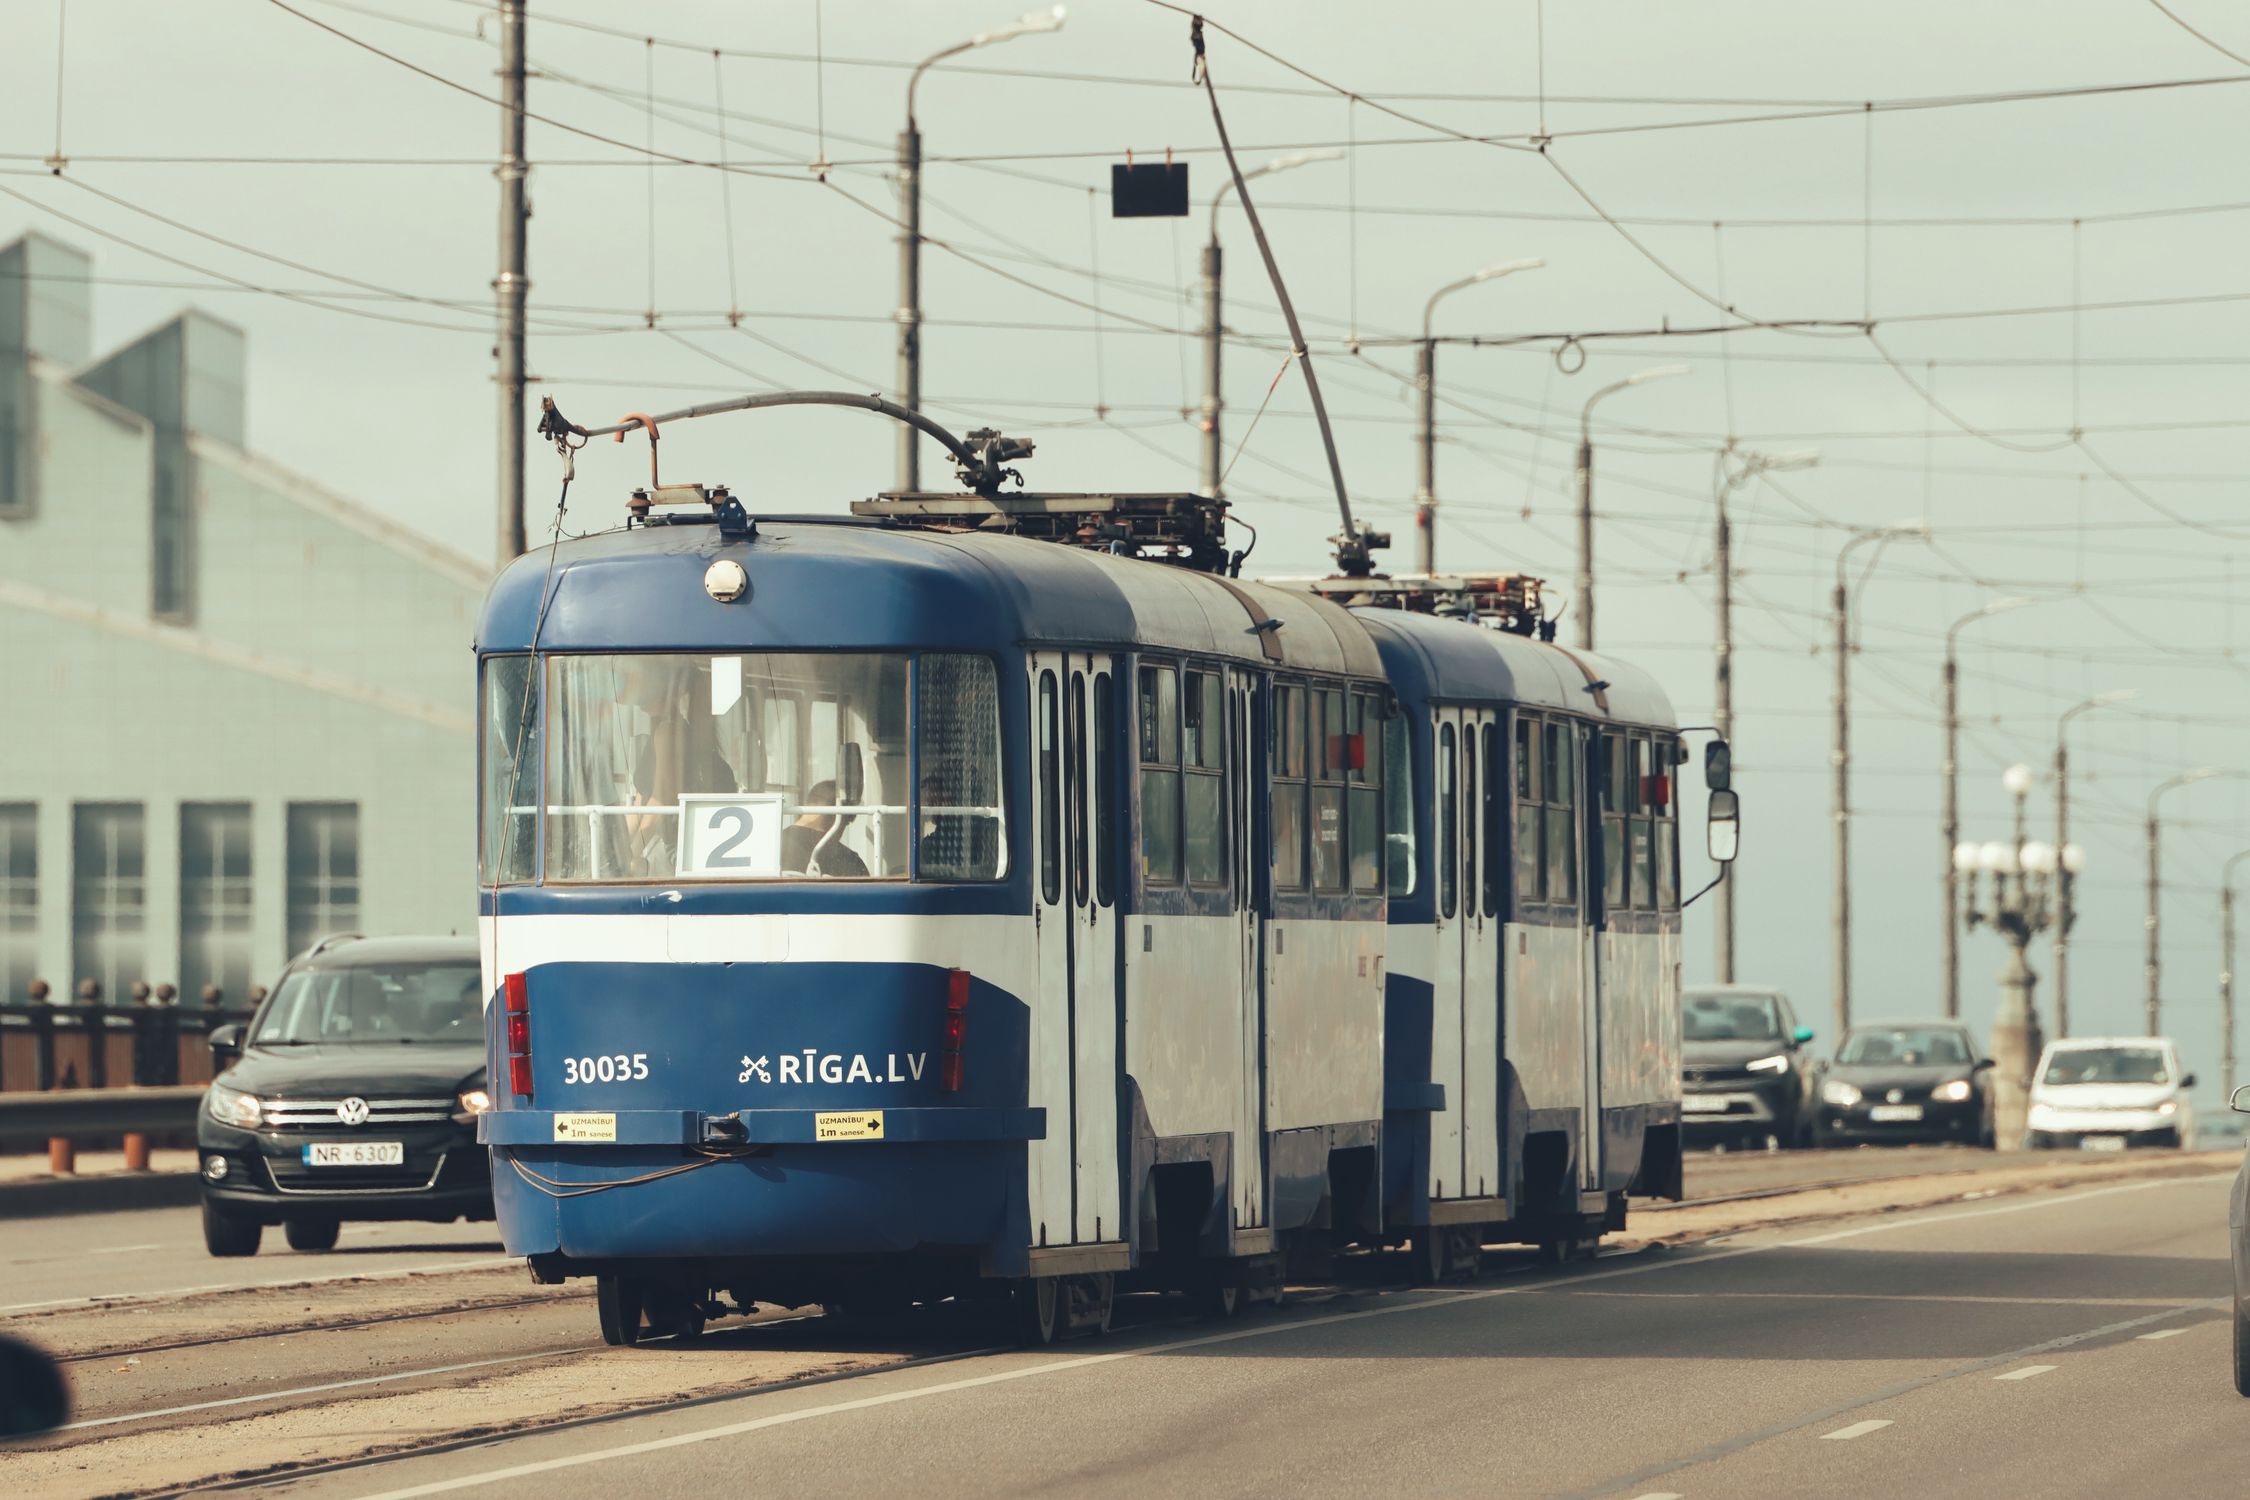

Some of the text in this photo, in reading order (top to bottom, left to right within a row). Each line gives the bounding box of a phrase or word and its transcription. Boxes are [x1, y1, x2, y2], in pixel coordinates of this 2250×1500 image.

[705, 806, 754, 868] 2
[563, 1053, 649, 1084] 30035
[779, 1048, 927, 1084] RĪGA.LV
[572, 1129, 586, 1137] 1m
[820, 1128, 837, 1137] 1m
